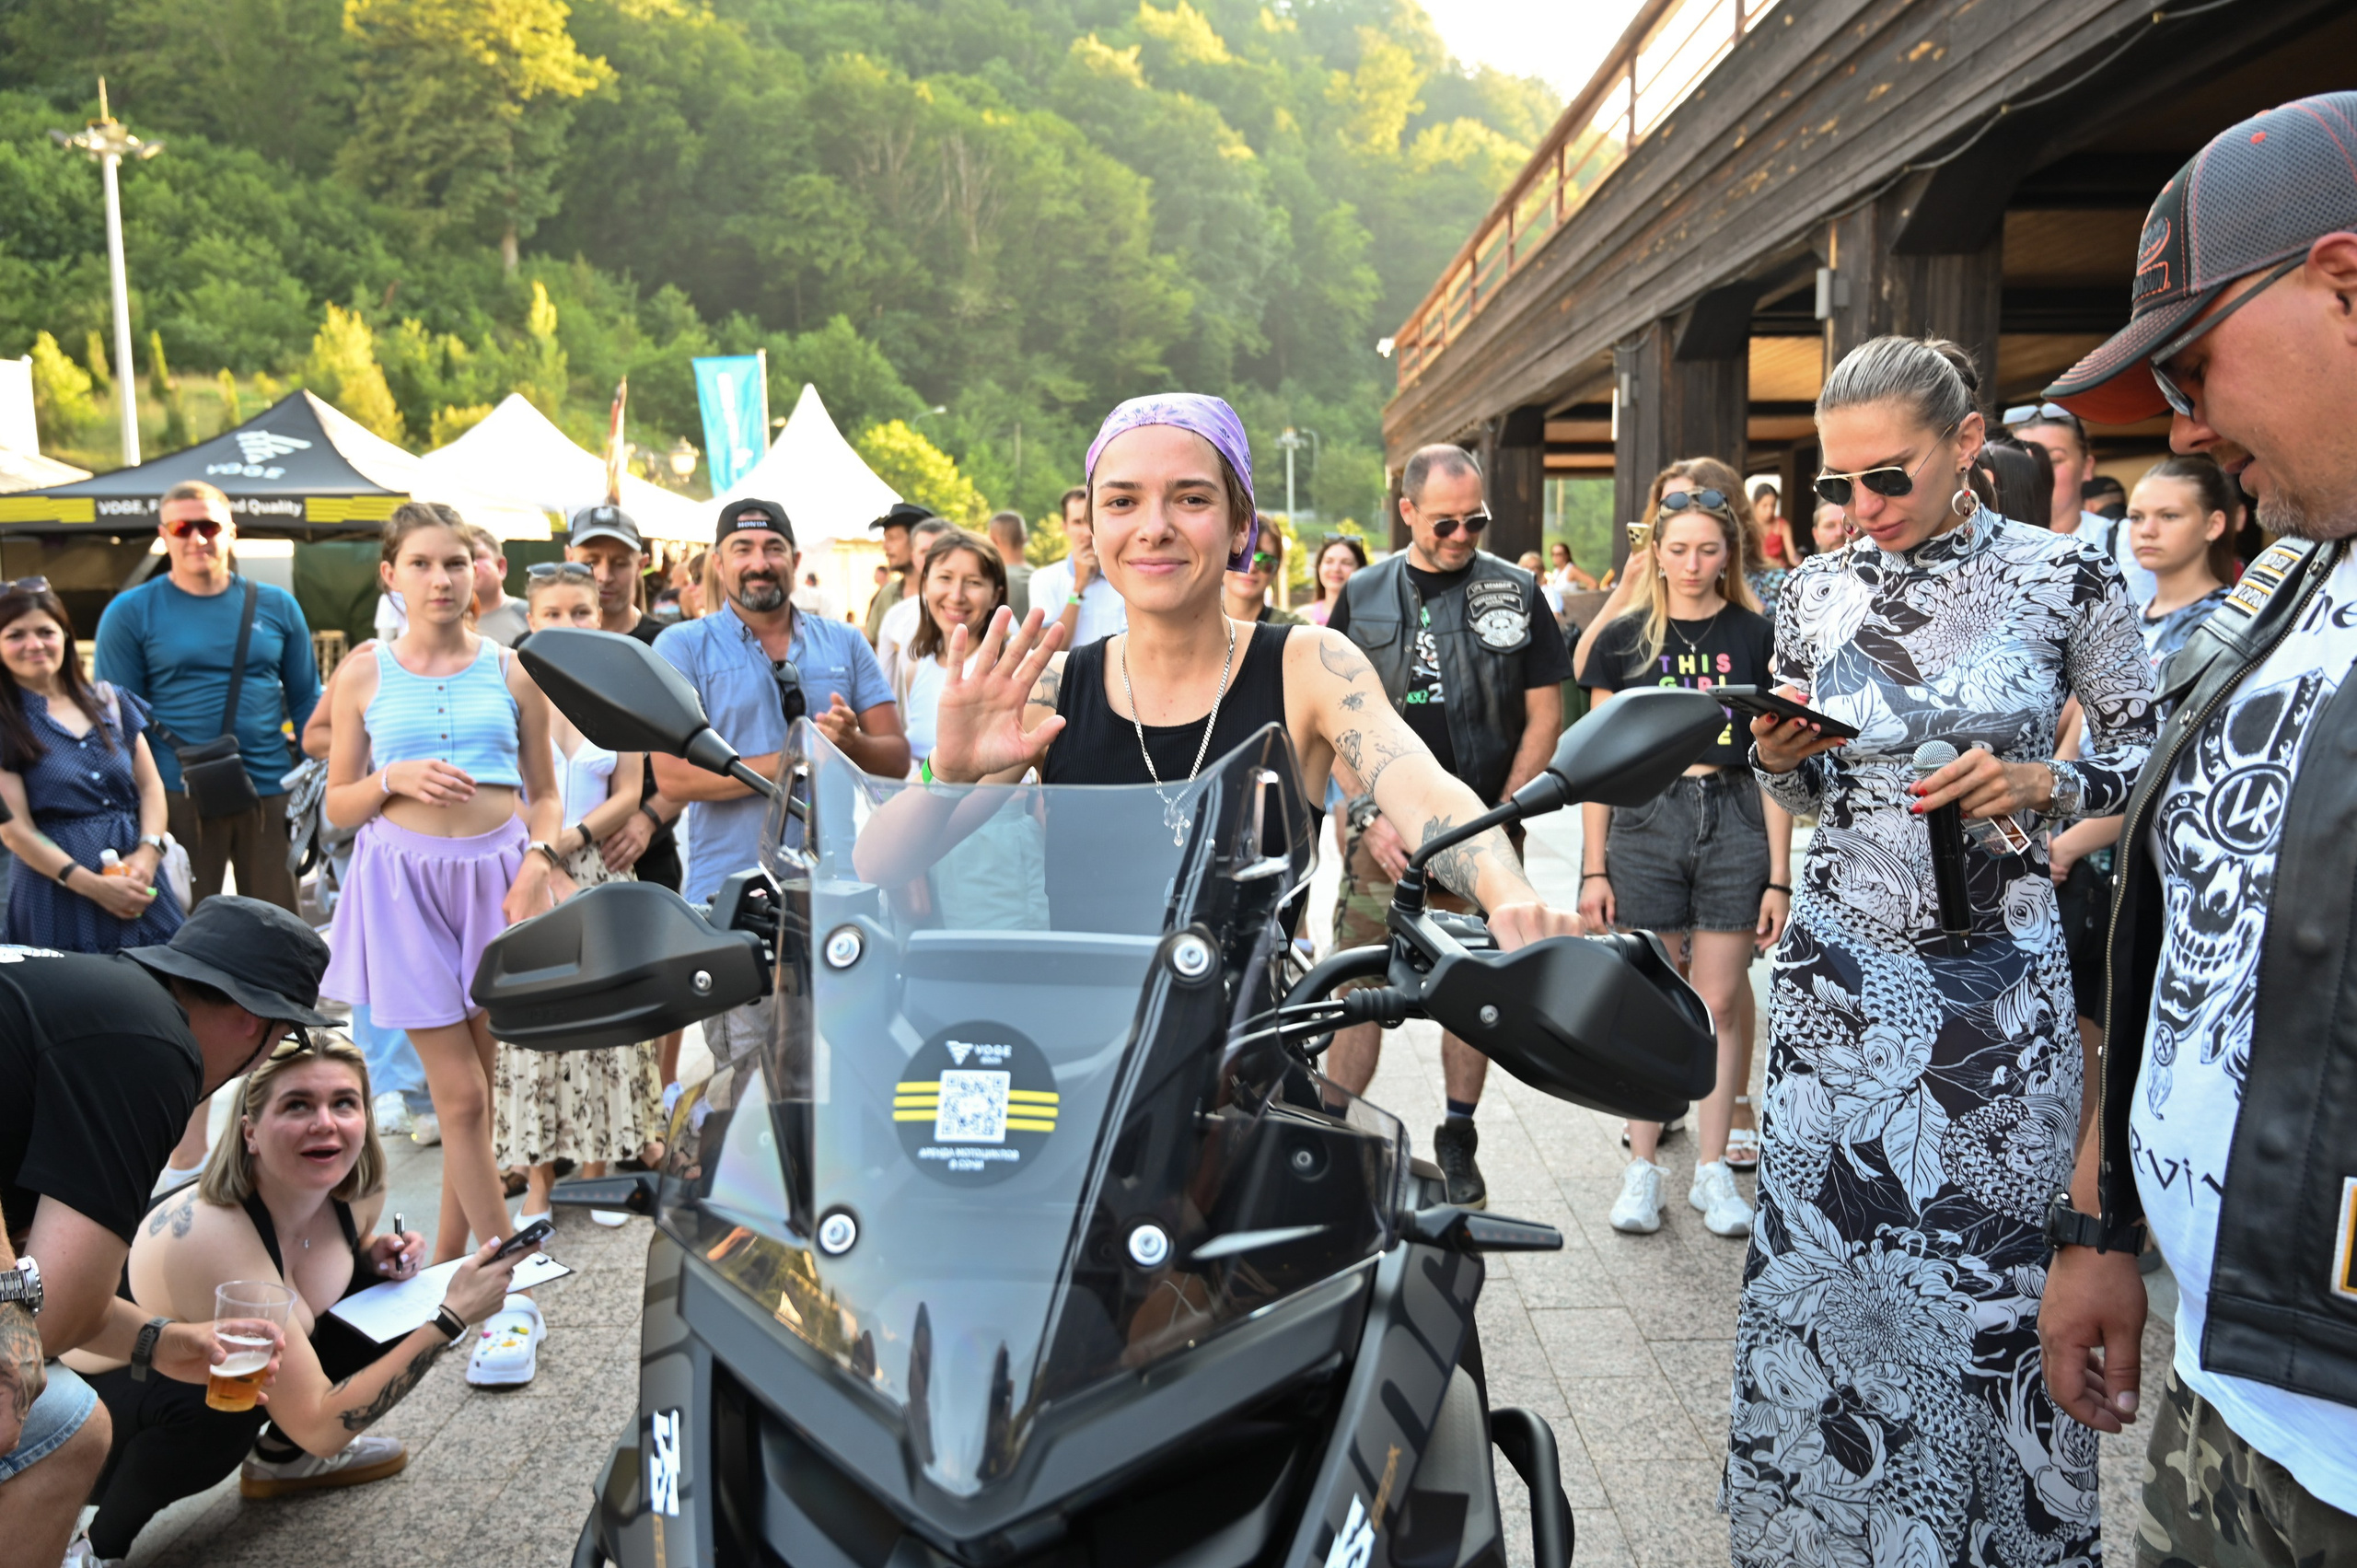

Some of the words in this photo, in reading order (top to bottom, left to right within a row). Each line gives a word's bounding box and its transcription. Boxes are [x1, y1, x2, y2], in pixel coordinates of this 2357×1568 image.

[205, 461, 285, 480] VOGE
[97, 498, 148, 517] VOGE,
[248, 498, 303, 517] Quality
[737, 520, 768, 528] HONDA
[1482, 610, 1515, 622] HARLEY
[1658, 653, 1732, 675] THIS
[2226, 777, 2282, 836] LR
[974, 1044, 1013, 1059] VOGE
[918, 1147, 955, 1160] АРЕНДА
[958, 1158, 984, 1171] СОЧИ
